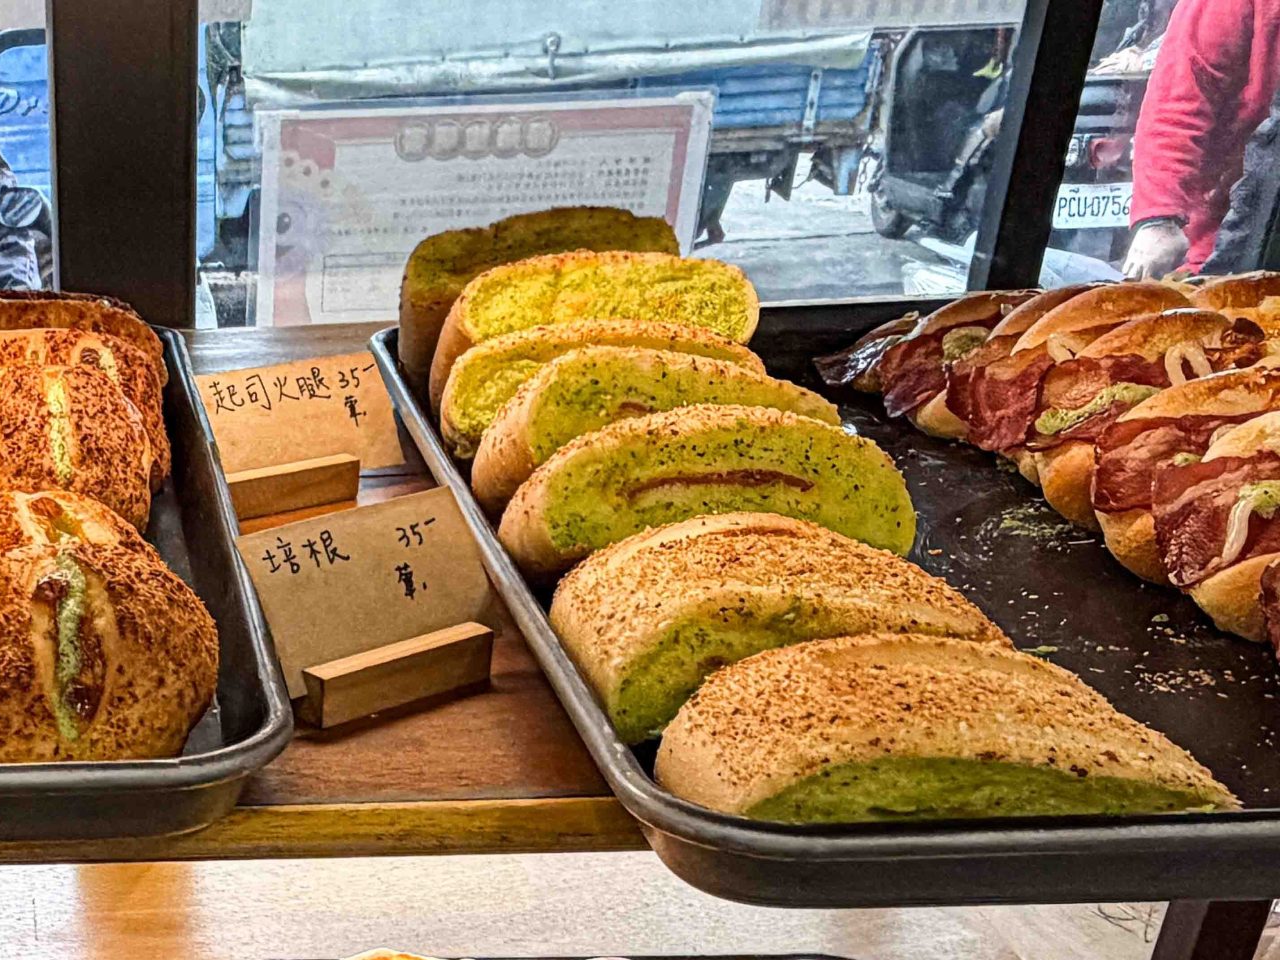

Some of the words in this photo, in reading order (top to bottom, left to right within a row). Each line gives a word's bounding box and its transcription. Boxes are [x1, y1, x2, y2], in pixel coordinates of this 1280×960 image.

[1057, 194, 1133, 218] PCU-0756
[209, 366, 332, 415] 起司火腿
[262, 529, 350, 574] 培根
